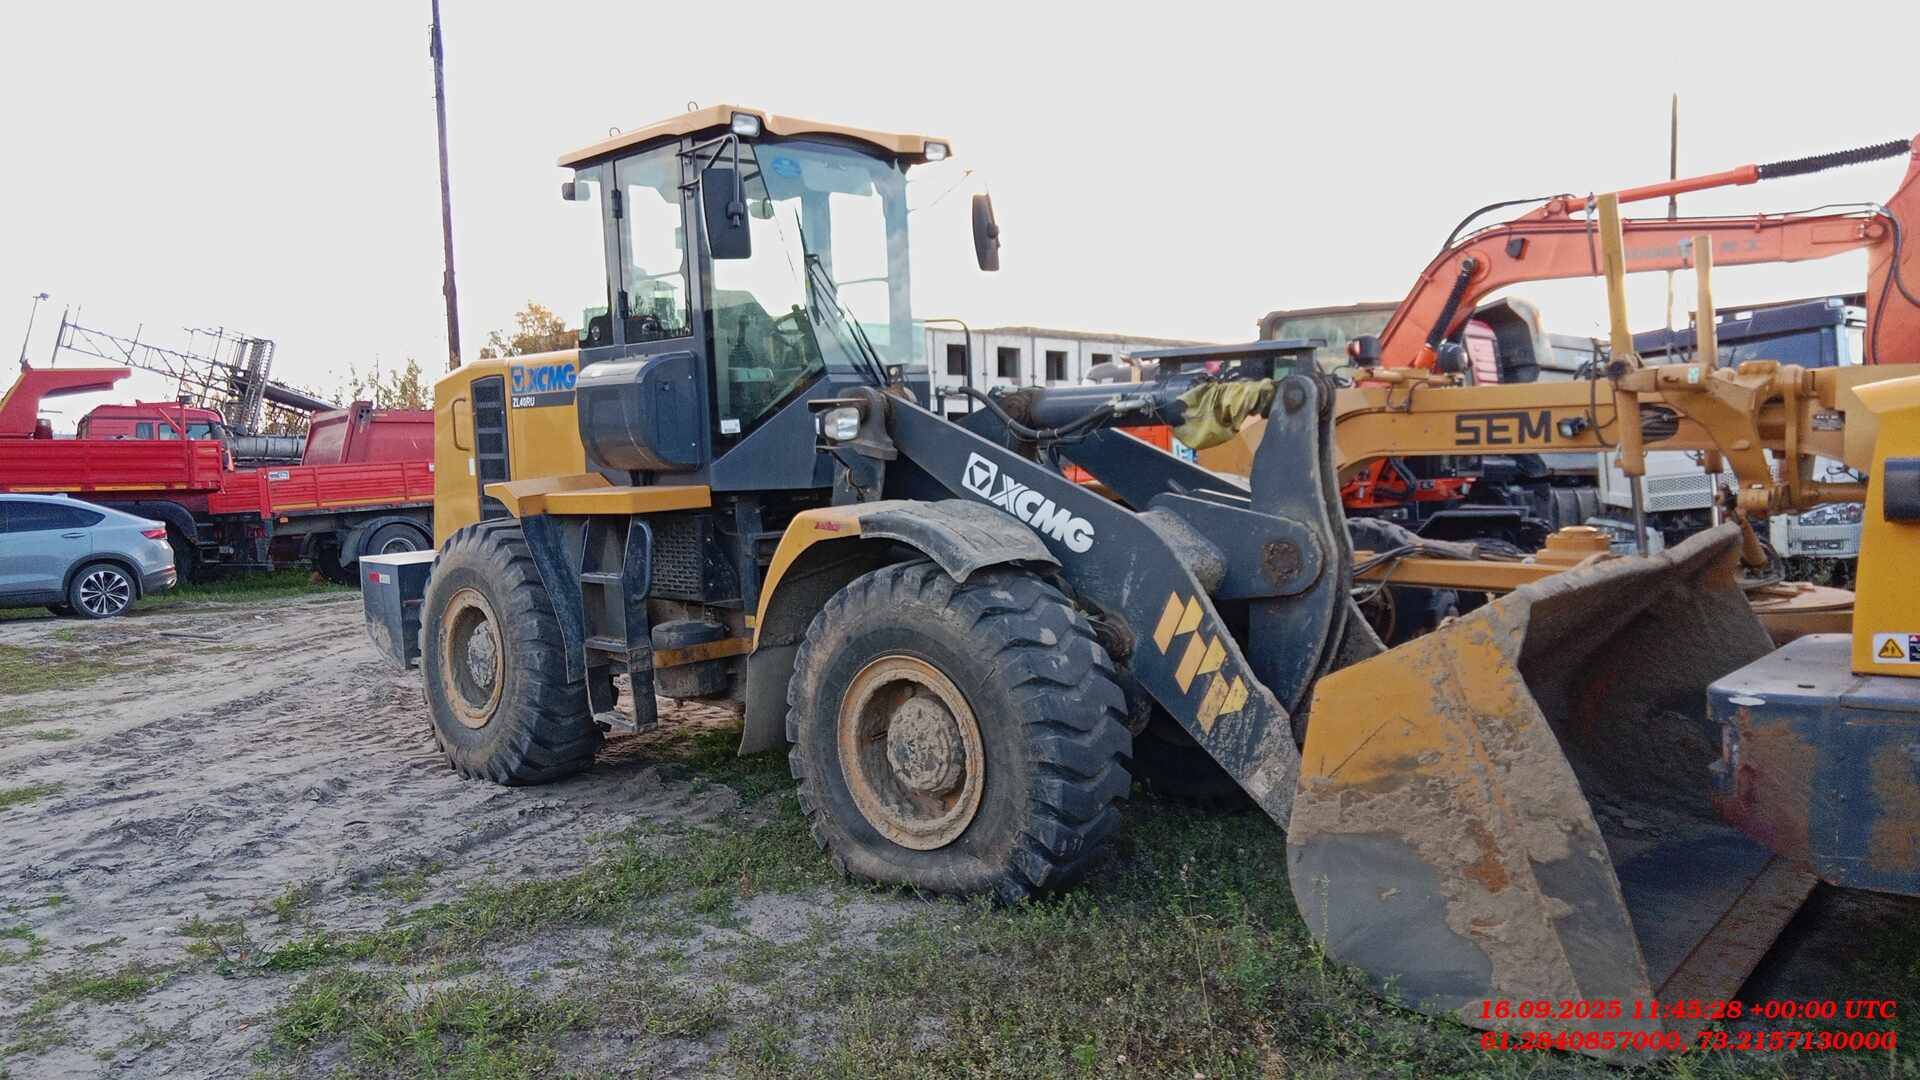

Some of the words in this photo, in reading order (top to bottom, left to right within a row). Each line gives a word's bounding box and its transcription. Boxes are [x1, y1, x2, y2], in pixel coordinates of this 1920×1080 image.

[525, 363, 577, 393] XCMG
[1455, 410, 1551, 446] SEM
[988, 473, 1095, 553] XCMG
